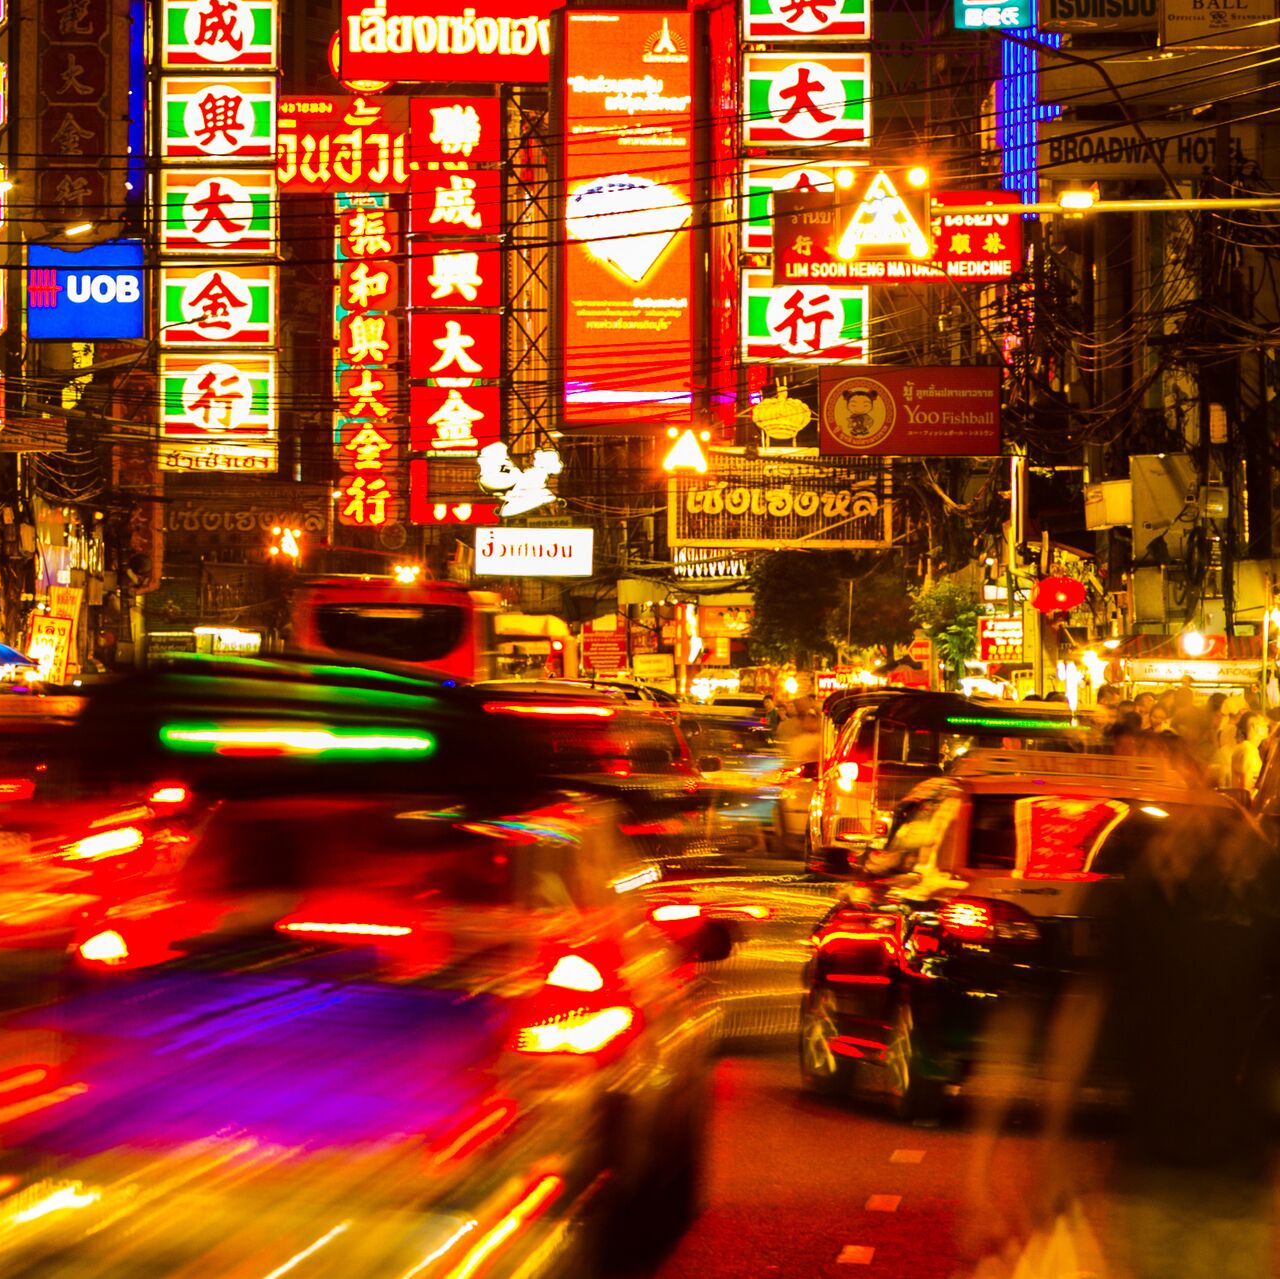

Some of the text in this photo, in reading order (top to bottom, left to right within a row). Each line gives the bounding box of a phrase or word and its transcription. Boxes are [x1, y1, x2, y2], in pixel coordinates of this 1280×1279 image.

[279, 102, 333, 114] งขายทอง
[278, 98, 468, 184] จินฮั้วเ
[1048, 137, 1170, 164] BROADWAY
[786, 260, 1012, 278] LIM SOON HENG NATURAL MEDICINE
[67, 274, 140, 303] UOB
[427, 104, 484, 521] 聯成興大金
[942, 411, 994, 425] Fishball
